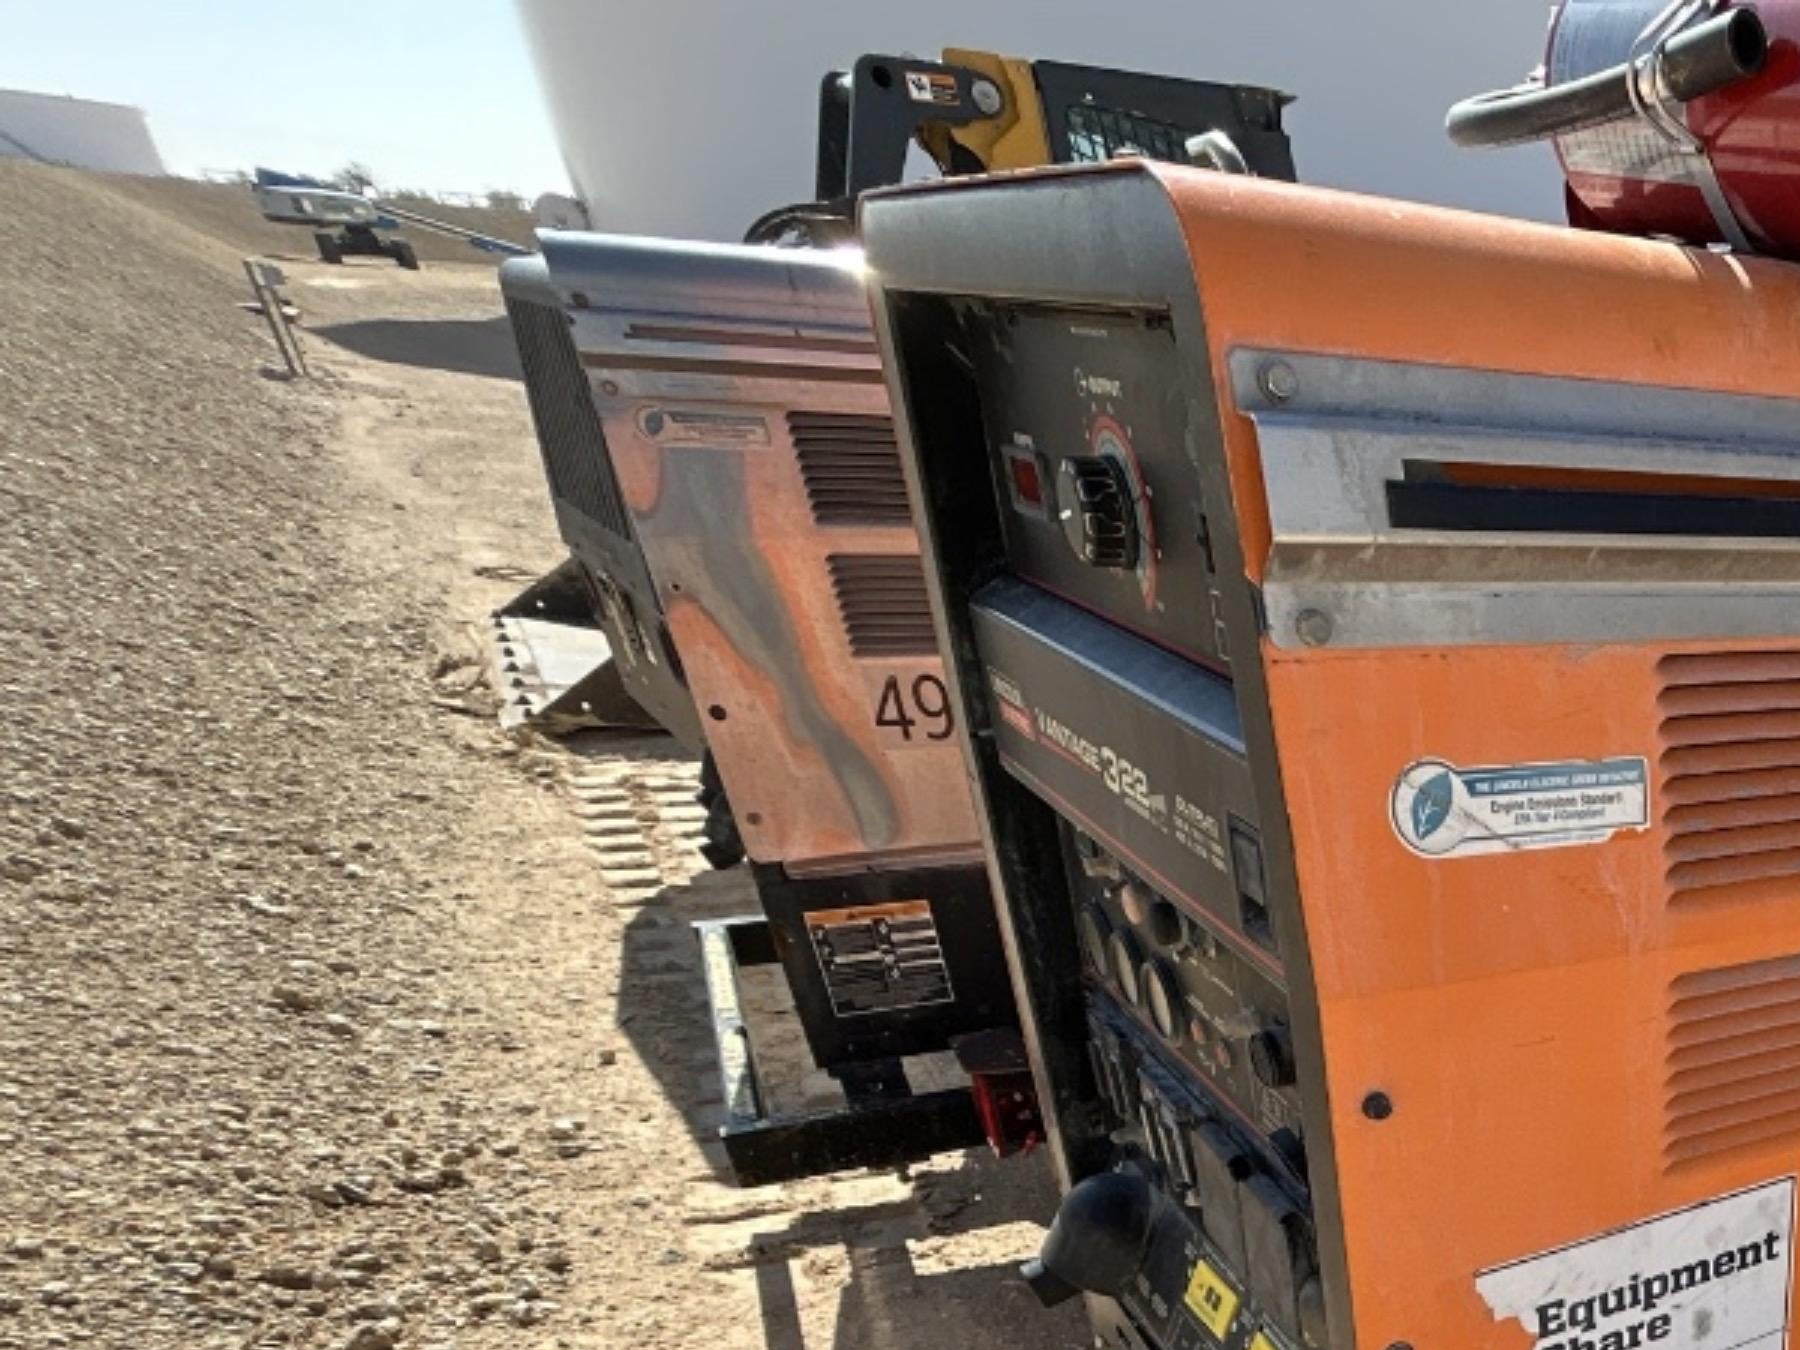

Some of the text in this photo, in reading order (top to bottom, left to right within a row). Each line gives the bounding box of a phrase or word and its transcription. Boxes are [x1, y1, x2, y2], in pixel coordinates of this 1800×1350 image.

[875, 673, 955, 741] 49
[1101, 746, 1150, 808] 322
[1535, 1229, 1781, 1340] Equipment
